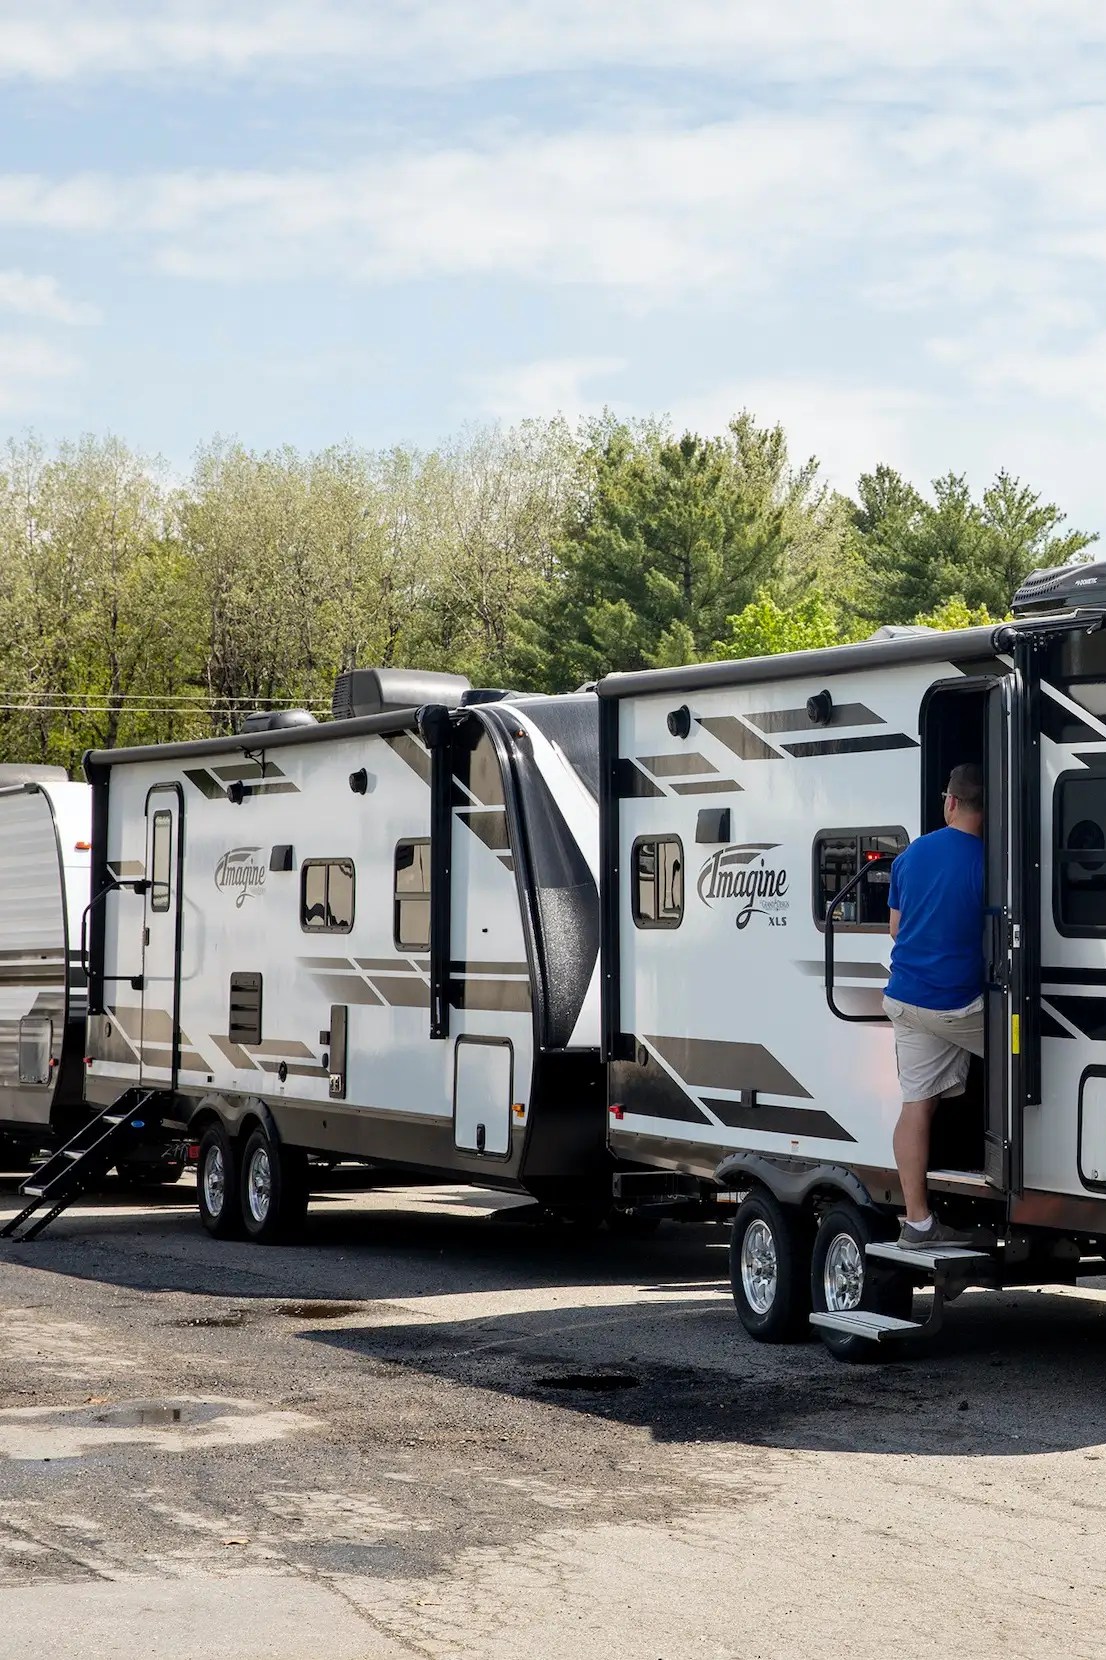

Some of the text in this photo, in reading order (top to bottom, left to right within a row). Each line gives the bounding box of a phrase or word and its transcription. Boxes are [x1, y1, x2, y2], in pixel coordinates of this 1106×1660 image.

[219, 850, 266, 909] Imagine
[705, 848, 790, 930] Imagine
[768, 916, 787, 927] XLS
